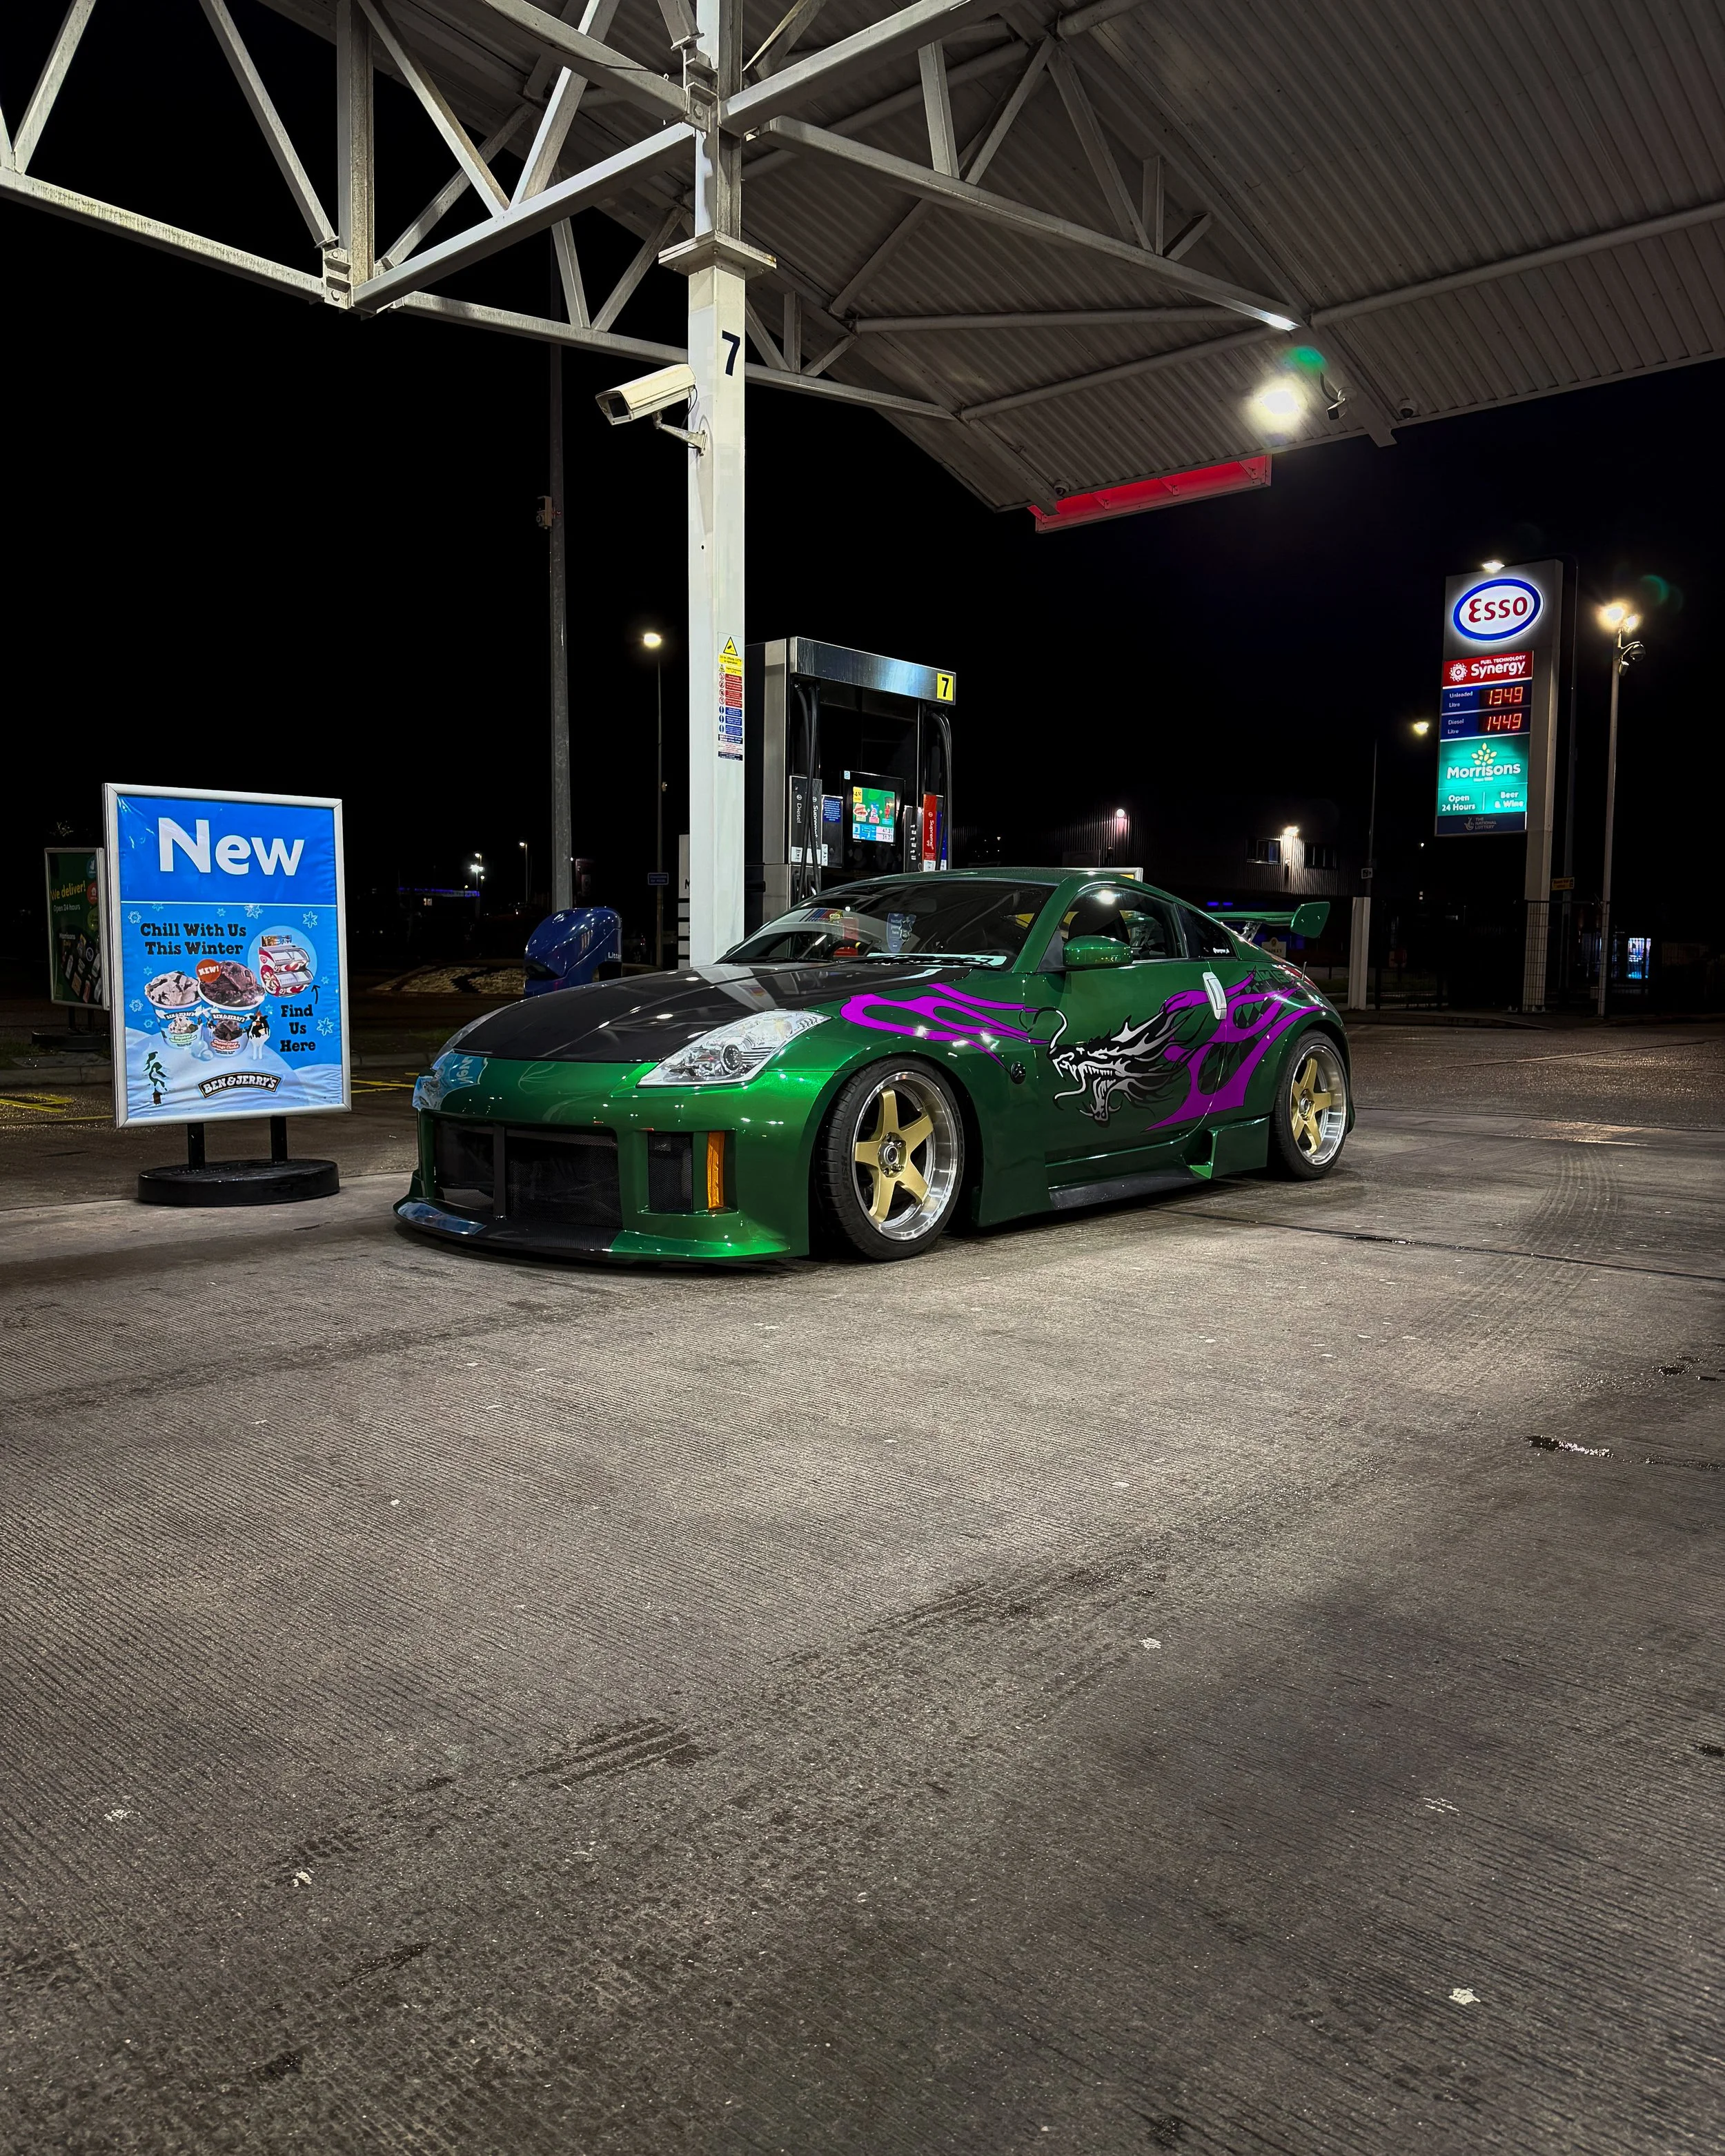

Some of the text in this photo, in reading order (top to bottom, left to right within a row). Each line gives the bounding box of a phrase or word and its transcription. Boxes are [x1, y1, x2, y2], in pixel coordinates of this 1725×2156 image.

[722, 330, 740, 376] 7
[1493, 655, 1526, 663] TECHNOLOGY
[1470, 661, 1526, 679] Synergy
[941, 677, 950, 697] 7
[1489, 686, 1524, 705] 1349
[1487, 713, 1522, 731] 1449
[1446, 762, 1521, 780] Morrisons
[1448, 794, 1470, 804] Open
[1503, 800, 1524, 808] Wine
[1452, 803, 1476, 811] Hours
[158, 817, 304, 876] New
[61, 880, 86, 897] deliver!
[140, 922, 247, 937] Chill With Us
[145, 941, 244, 955] This Winter
[198, 965, 219, 976] NEW!
[281, 1004, 314, 1018] Find
[288, 1022, 307, 1035] Us
[280, 1039, 316, 1053] Here
